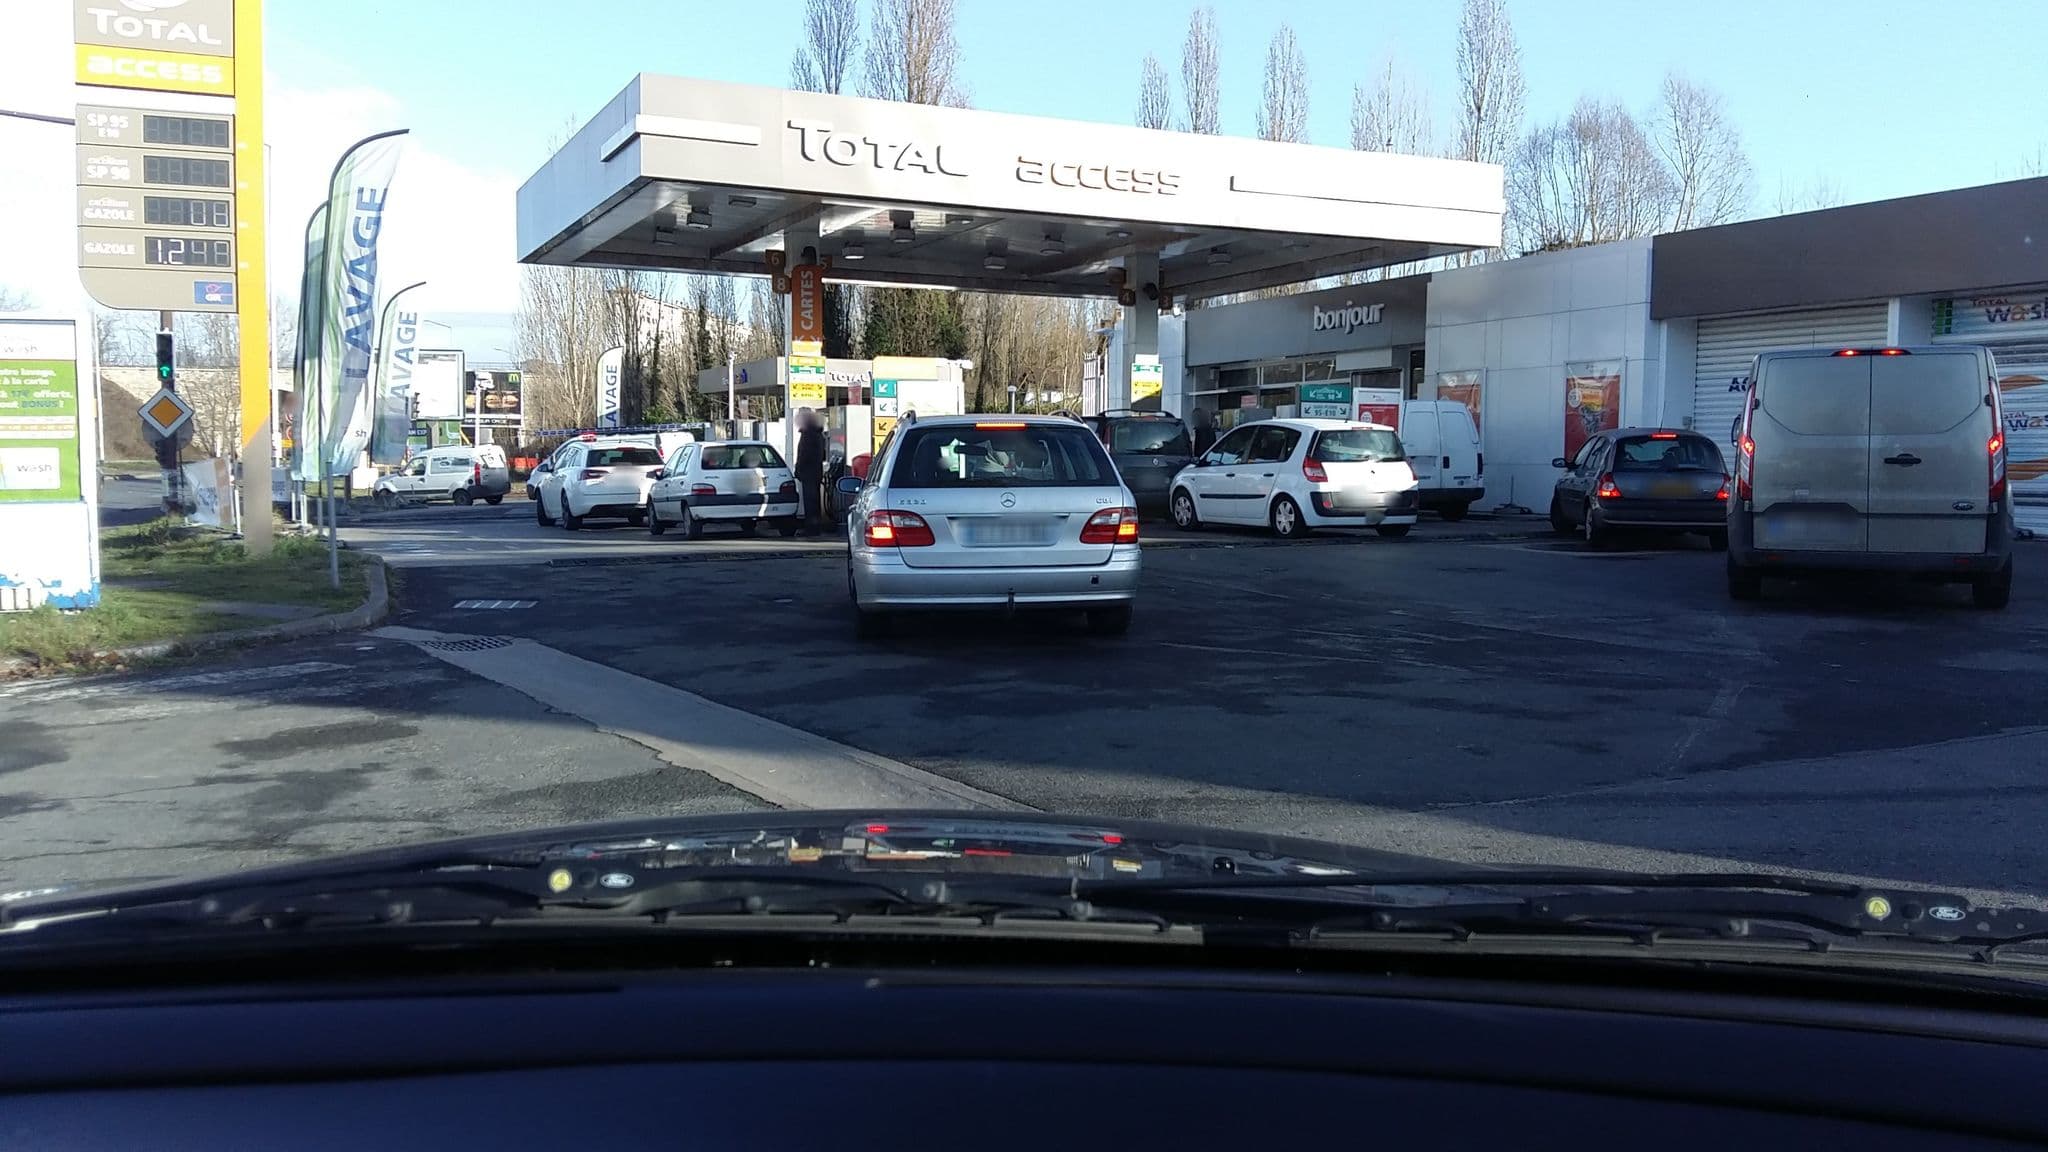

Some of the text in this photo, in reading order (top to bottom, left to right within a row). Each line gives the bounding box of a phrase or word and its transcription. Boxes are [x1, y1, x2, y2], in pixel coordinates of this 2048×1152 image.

[87, 8, 222, 46] TOTAL
[87, 56, 222, 84] access
[109, 115, 129, 129] 95
[787, 119, 1181, 195] TOTAL access
[84, 207, 136, 221] GAZOLE
[84, 242, 136, 256] GAZOLE
[345, 186, 389, 379] LAVAGE
[800, 270, 814, 330] CARTES
[1313, 301, 1386, 335] bonjour
[390, 311, 418, 416] LAVAGE
